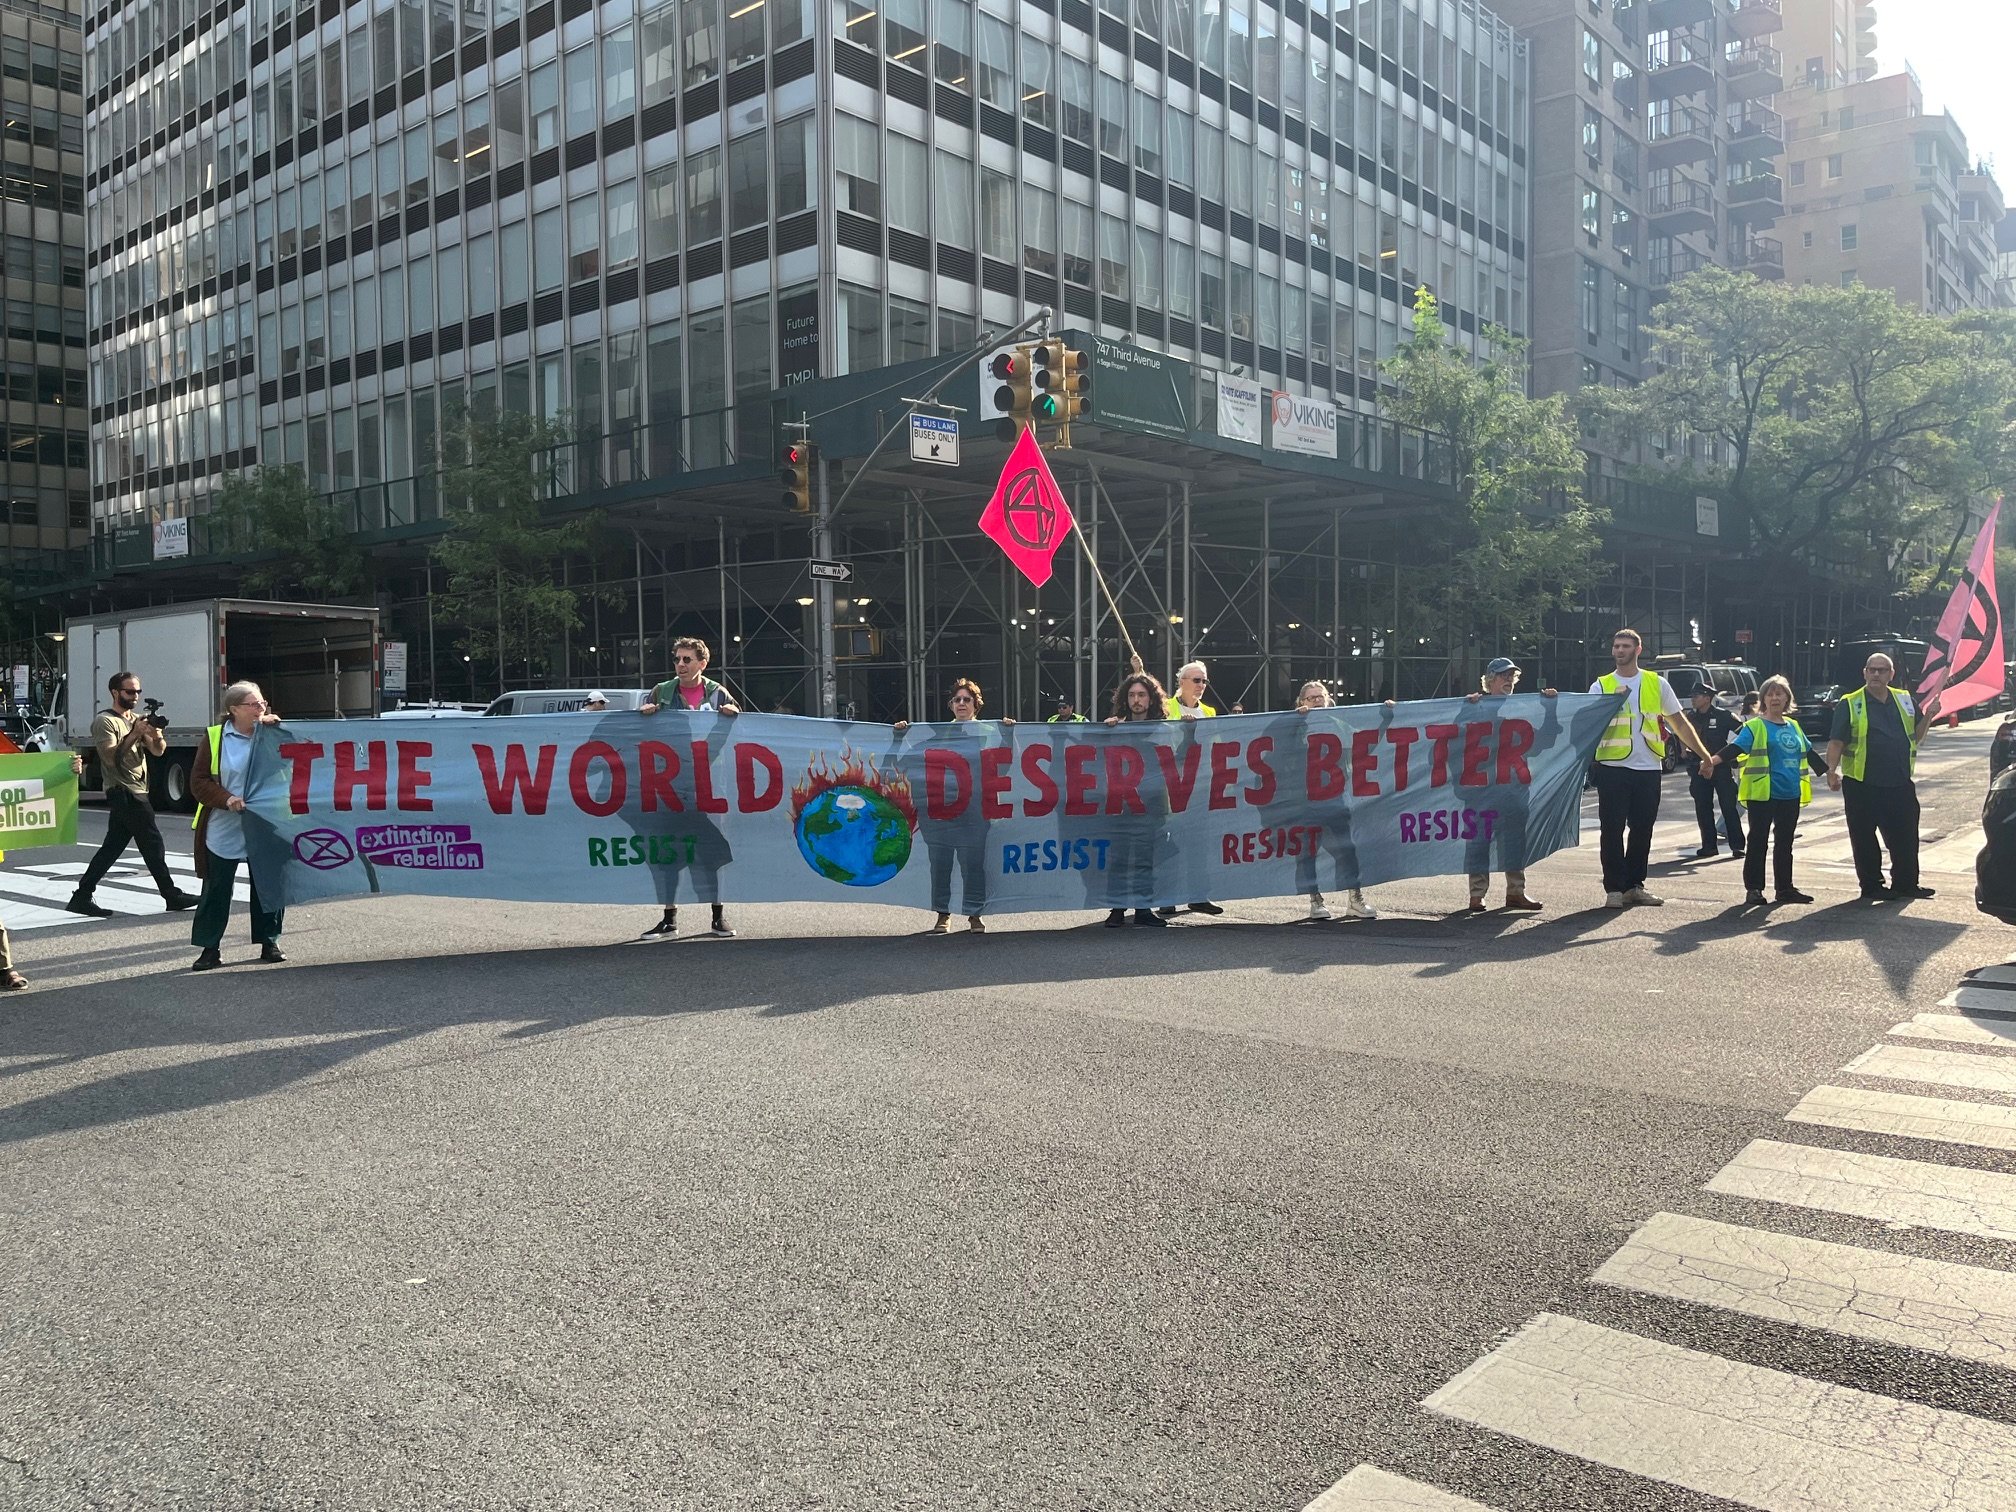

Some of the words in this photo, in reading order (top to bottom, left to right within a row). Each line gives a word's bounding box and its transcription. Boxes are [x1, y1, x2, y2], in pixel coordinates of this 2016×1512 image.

[786, 315, 815, 331] Future
[783, 335, 808, 350] Home
[809, 332, 819, 343] to
[1096, 342, 1110, 356] 747
[1111, 345, 1132, 362] Third
[1132, 352, 1161, 370] Avenue
[922, 418, 937, 428] BUS
[937, 422, 956, 432] LANE
[1293, 402, 1335, 431] VIKING
[914, 429, 936, 441] BUSES
[938, 432, 955, 443] ONLY
[162, 522, 186, 539] VIKING
[814, 565, 827, 575] ONE
[832, 567, 845, 576] WAY
[279, 740, 434, 815] THE
[472, 740, 784, 817] WORLD
[924, 736, 1277, 821] DESERVES
[1306, 718, 1535, 801] BETTER
[360, 825, 456, 848] extinction
[1400, 808, 1499, 844] RESIST
[393, 842, 480, 868] rebellion
[588, 834, 697, 868] RESIST
[1003, 838, 1112, 875] RESIST
[1223, 825, 1323, 866] RESIST
